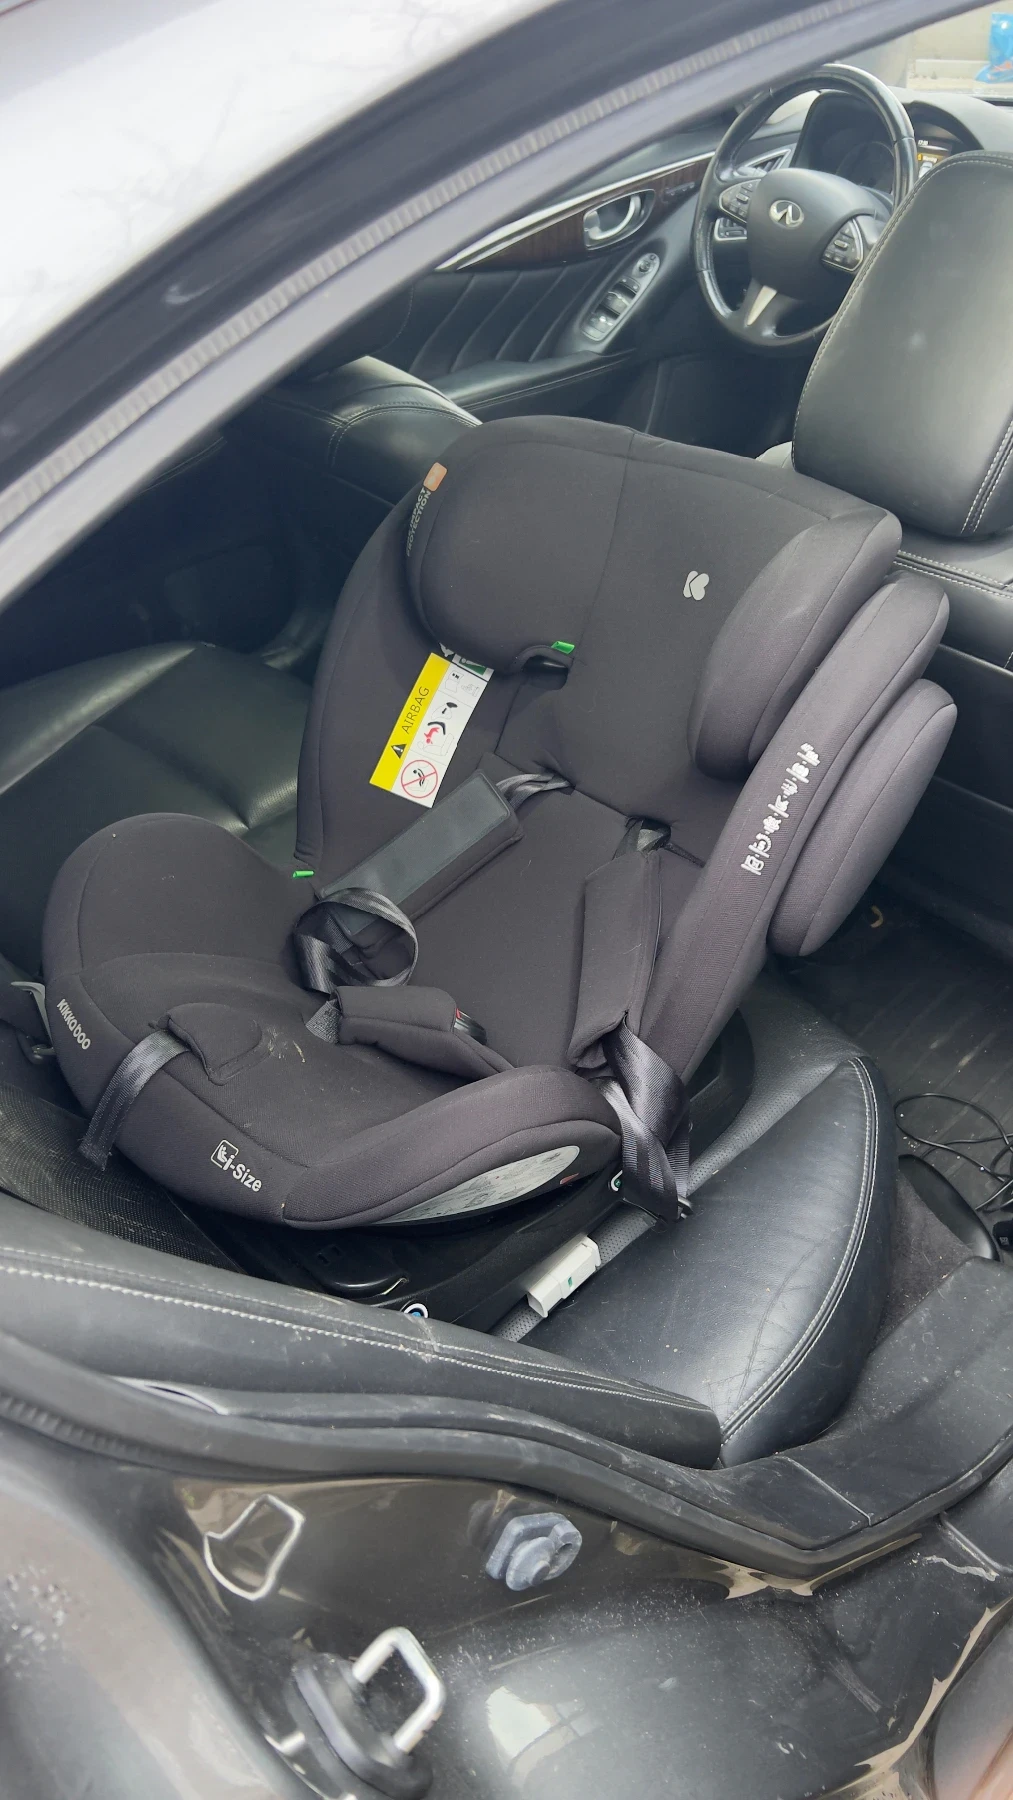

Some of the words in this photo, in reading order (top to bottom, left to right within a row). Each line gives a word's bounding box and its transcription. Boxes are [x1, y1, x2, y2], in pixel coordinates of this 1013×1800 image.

[406, 490, 432, 557] PROTECTION
[402, 686, 430, 734] AIRBAG
[222, 1154, 262, 1192] i-Size
